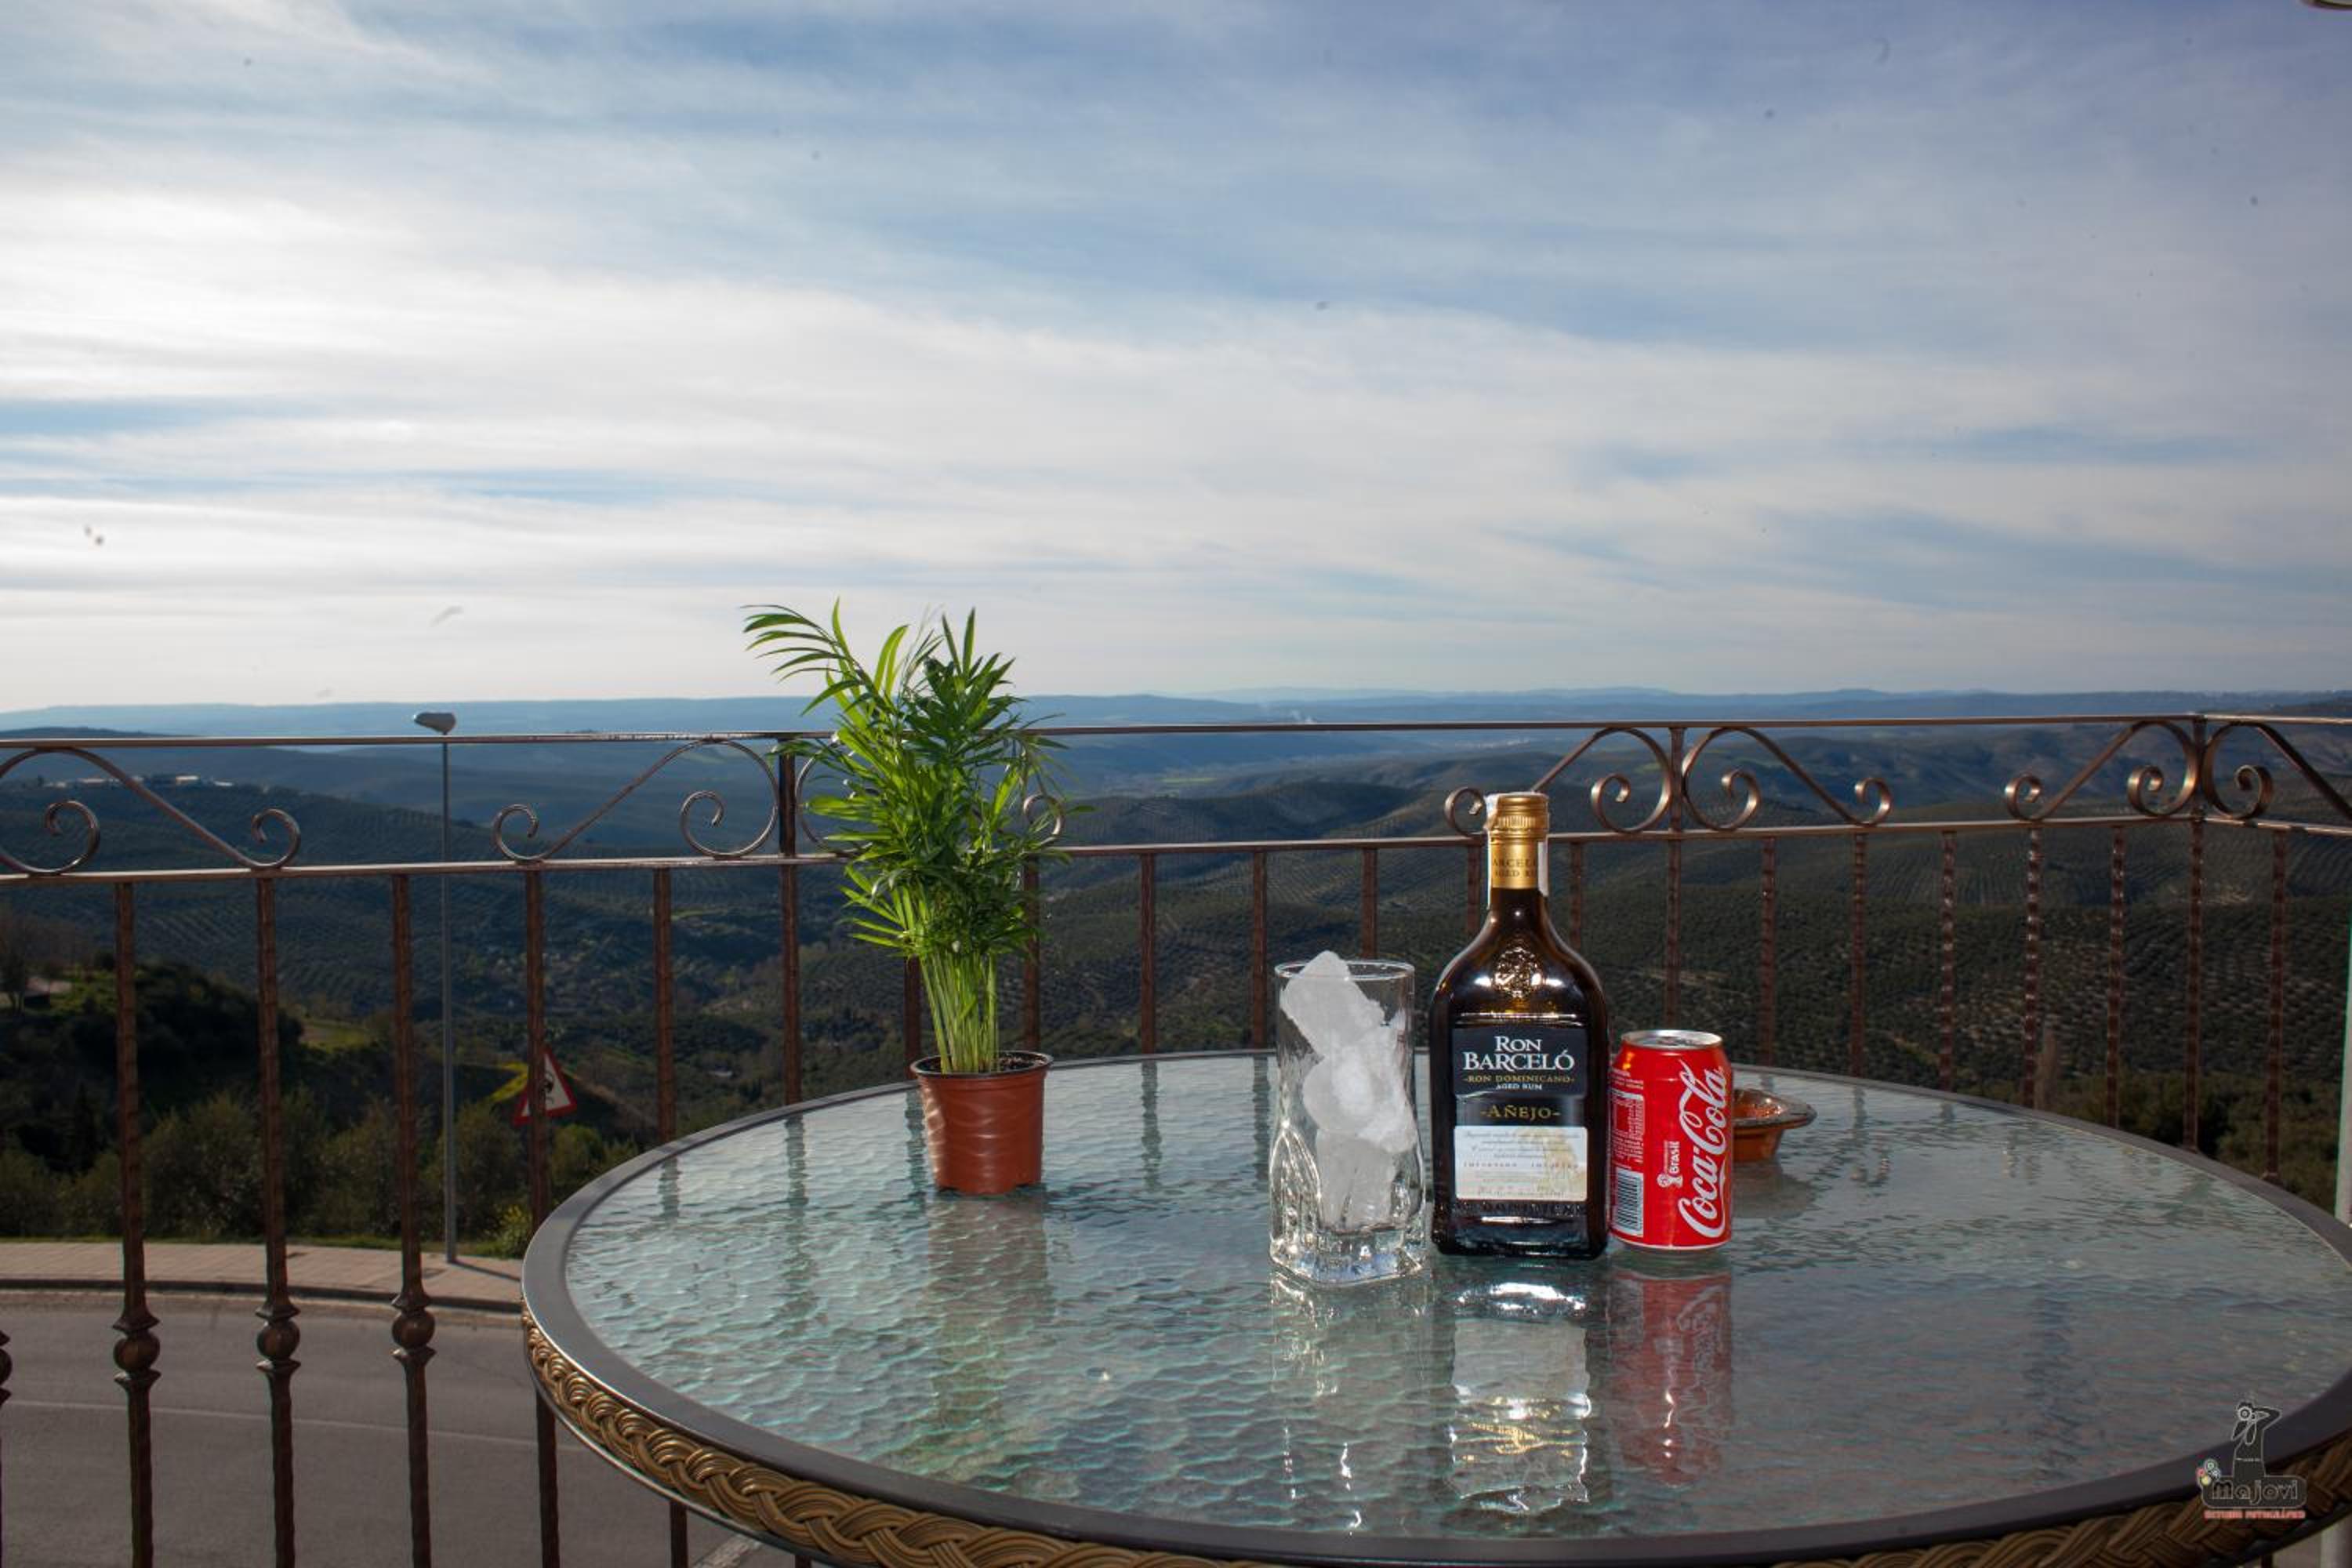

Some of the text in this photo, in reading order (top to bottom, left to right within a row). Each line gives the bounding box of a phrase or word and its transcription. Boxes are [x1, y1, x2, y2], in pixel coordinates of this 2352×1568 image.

[1462, 1049, 1575, 1073] BARCELÓ
[1522, 1083, 1543, 1091] RUM
[1678, 1058, 1727, 1239] Coca-Cola
